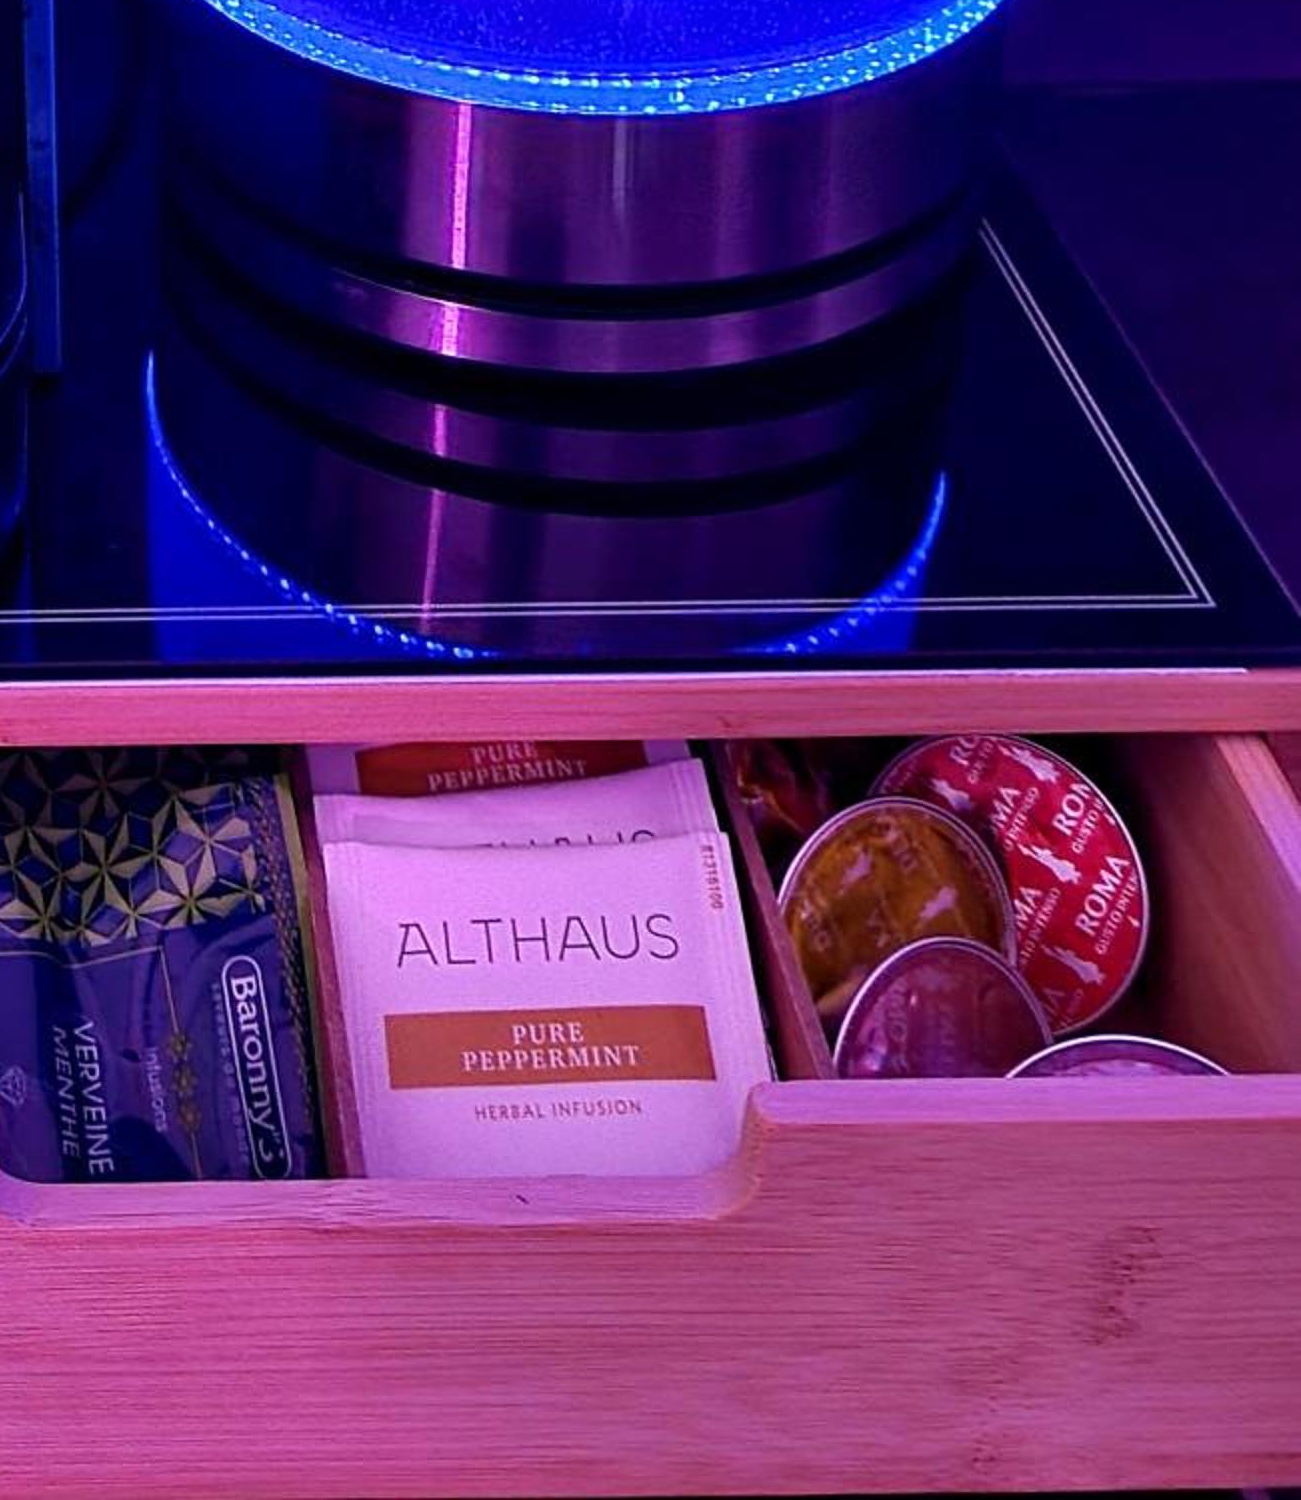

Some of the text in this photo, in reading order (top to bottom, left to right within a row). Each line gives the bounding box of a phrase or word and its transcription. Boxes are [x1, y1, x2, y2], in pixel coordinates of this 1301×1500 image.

[471, 740, 539, 765] PURE
[427, 759, 587, 792] PEPPERMINT
[1075, 856, 1130, 936] ROMA
[397, 913, 680, 968] ALTHAUS
[511, 1021, 585, 1046] PURE
[462, 1045, 640, 1072] PEPPERMINT
[52, 1025, 81, 1159] MENTHE
[74, 1019, 114, 1175] VERVEINE
[475, 1098, 643, 1121] HERBAL INFUSION
